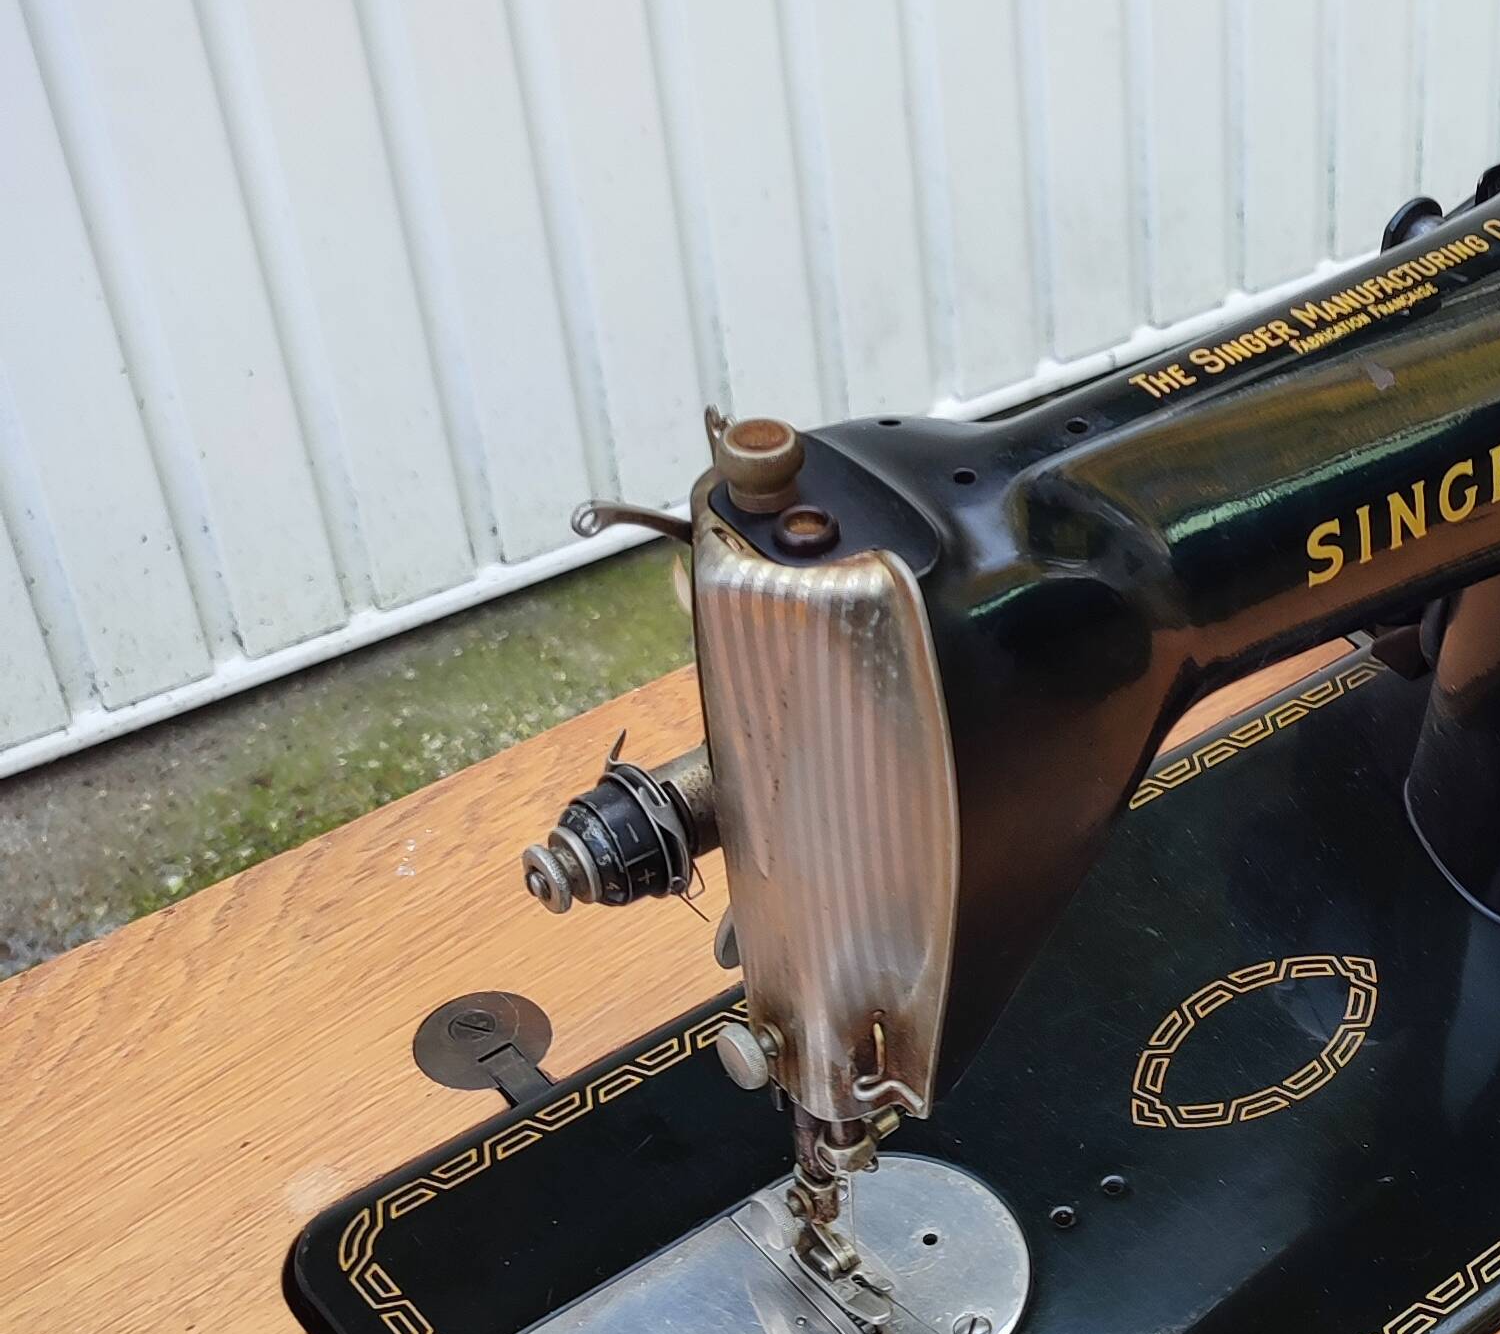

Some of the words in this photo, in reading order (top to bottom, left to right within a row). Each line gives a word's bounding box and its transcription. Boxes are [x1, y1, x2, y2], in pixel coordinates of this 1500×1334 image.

[1128, 363, 1197, 400] THE
[1189, 318, 1299, 376] SINGER
[1289, 233, 1490, 330] MANUFACTURING
